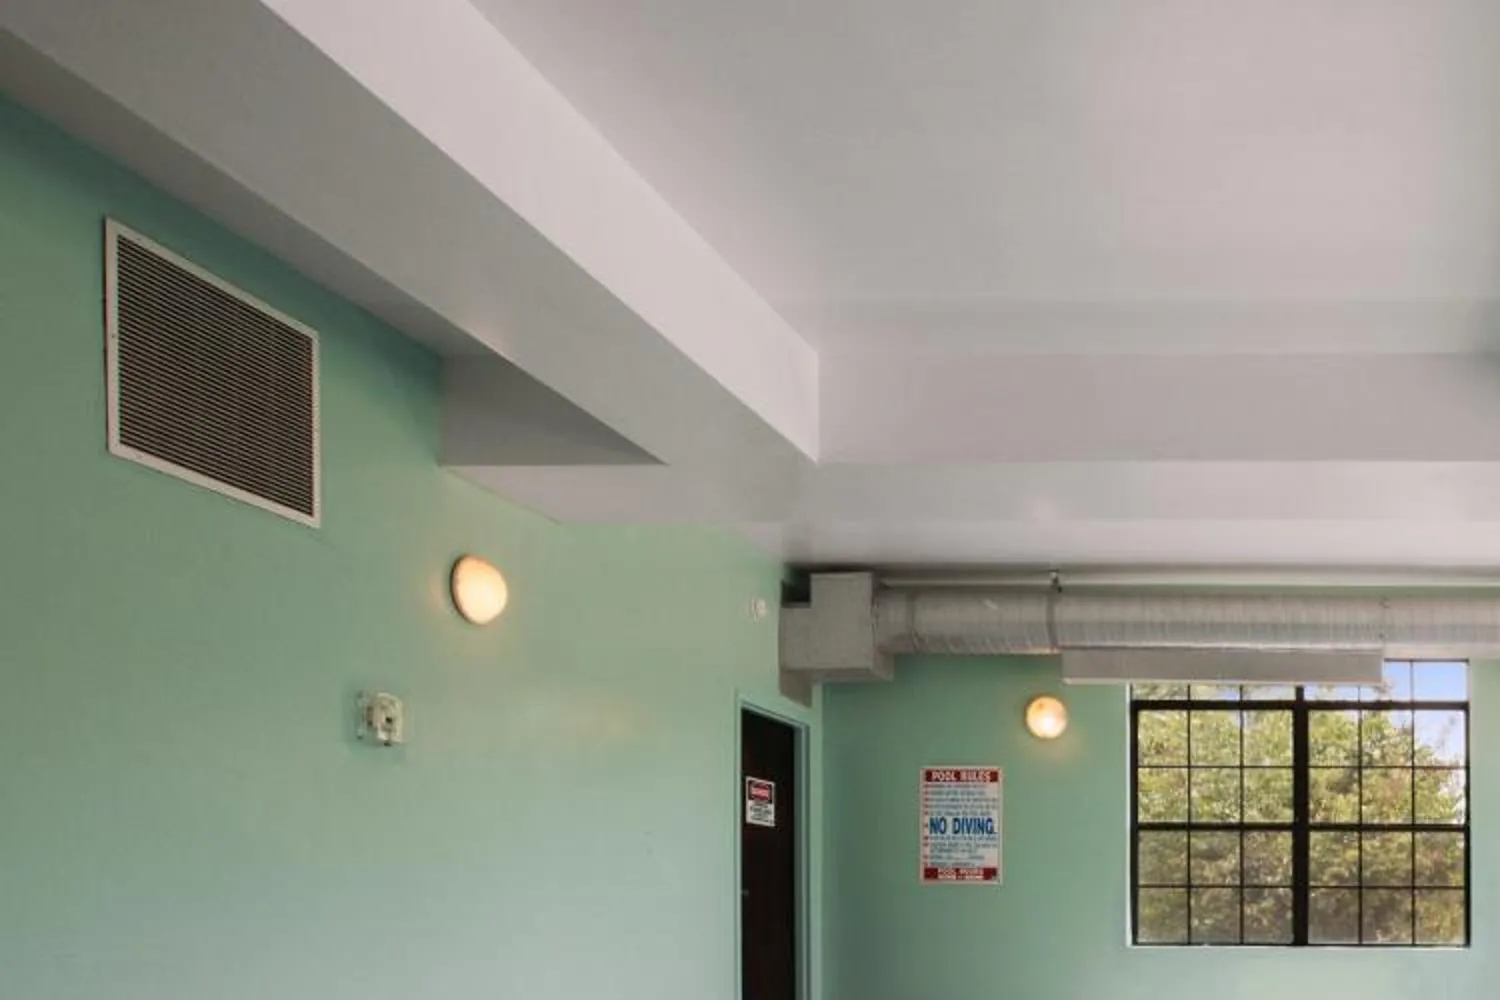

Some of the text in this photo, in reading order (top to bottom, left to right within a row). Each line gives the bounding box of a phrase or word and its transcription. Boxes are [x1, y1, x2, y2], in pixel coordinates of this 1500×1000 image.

[931, 770, 990, 781] POOL RULES
[929, 817, 947, 834] NO
